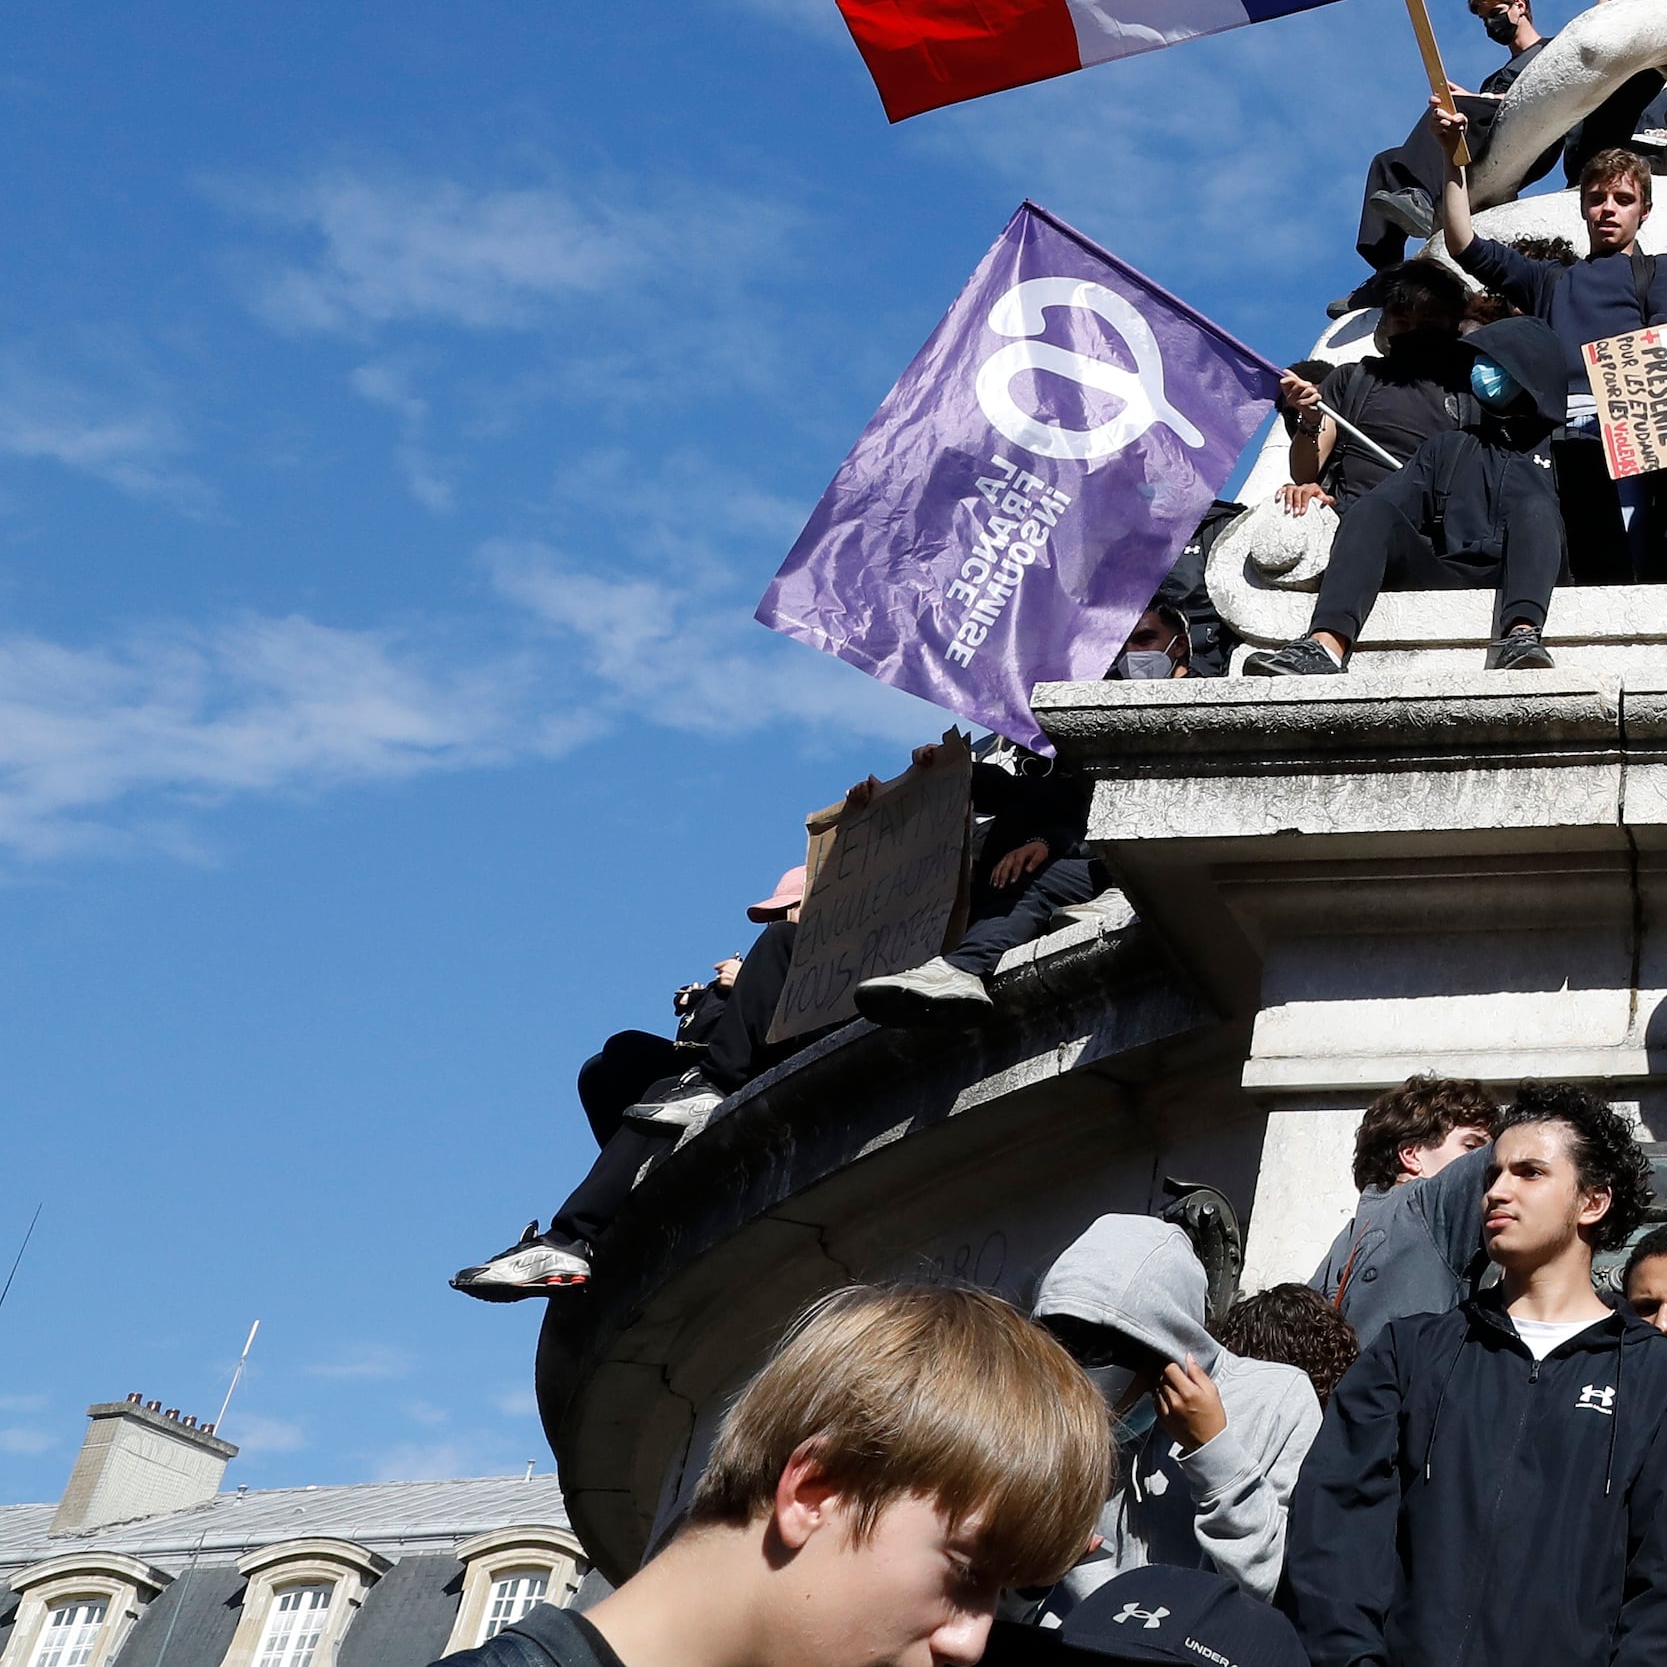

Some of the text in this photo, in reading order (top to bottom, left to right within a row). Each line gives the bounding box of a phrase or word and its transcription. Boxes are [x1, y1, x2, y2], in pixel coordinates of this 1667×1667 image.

[1596, 341, 1613, 363] QUE
[1616, 335, 1639, 368] POUR
[1600, 364, 1622, 399] POUR
[1624, 374, 1647, 396] LES
[1608, 400, 1629, 422] LES
[1184, 1636, 1231, 1667] UNDER
